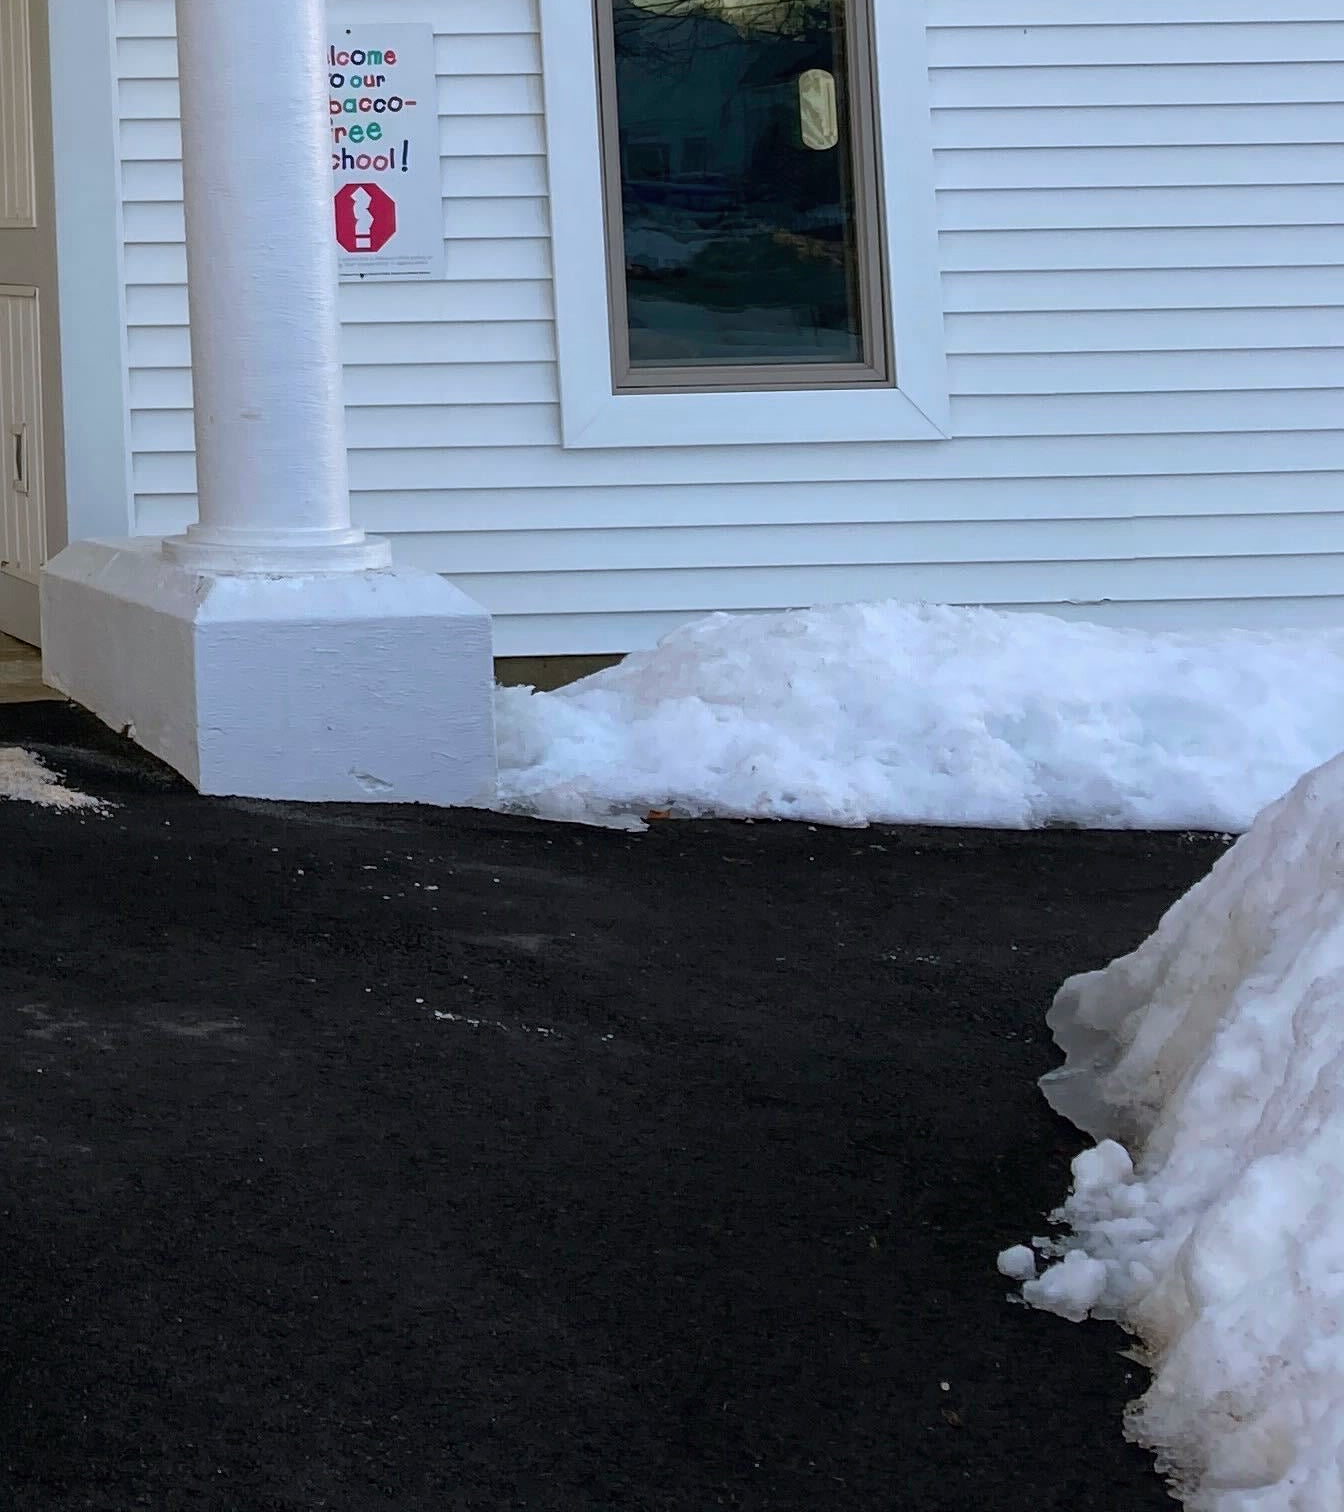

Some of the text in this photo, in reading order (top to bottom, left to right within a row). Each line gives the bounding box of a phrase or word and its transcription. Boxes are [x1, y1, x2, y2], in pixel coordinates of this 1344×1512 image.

[327, 45, 397, 66] lcome
[350, 74, 386, 89] our
[329, 95, 417, 115] bacco-
[330, 118, 383, 144] ree
[331, 140, 409, 173] chool!
